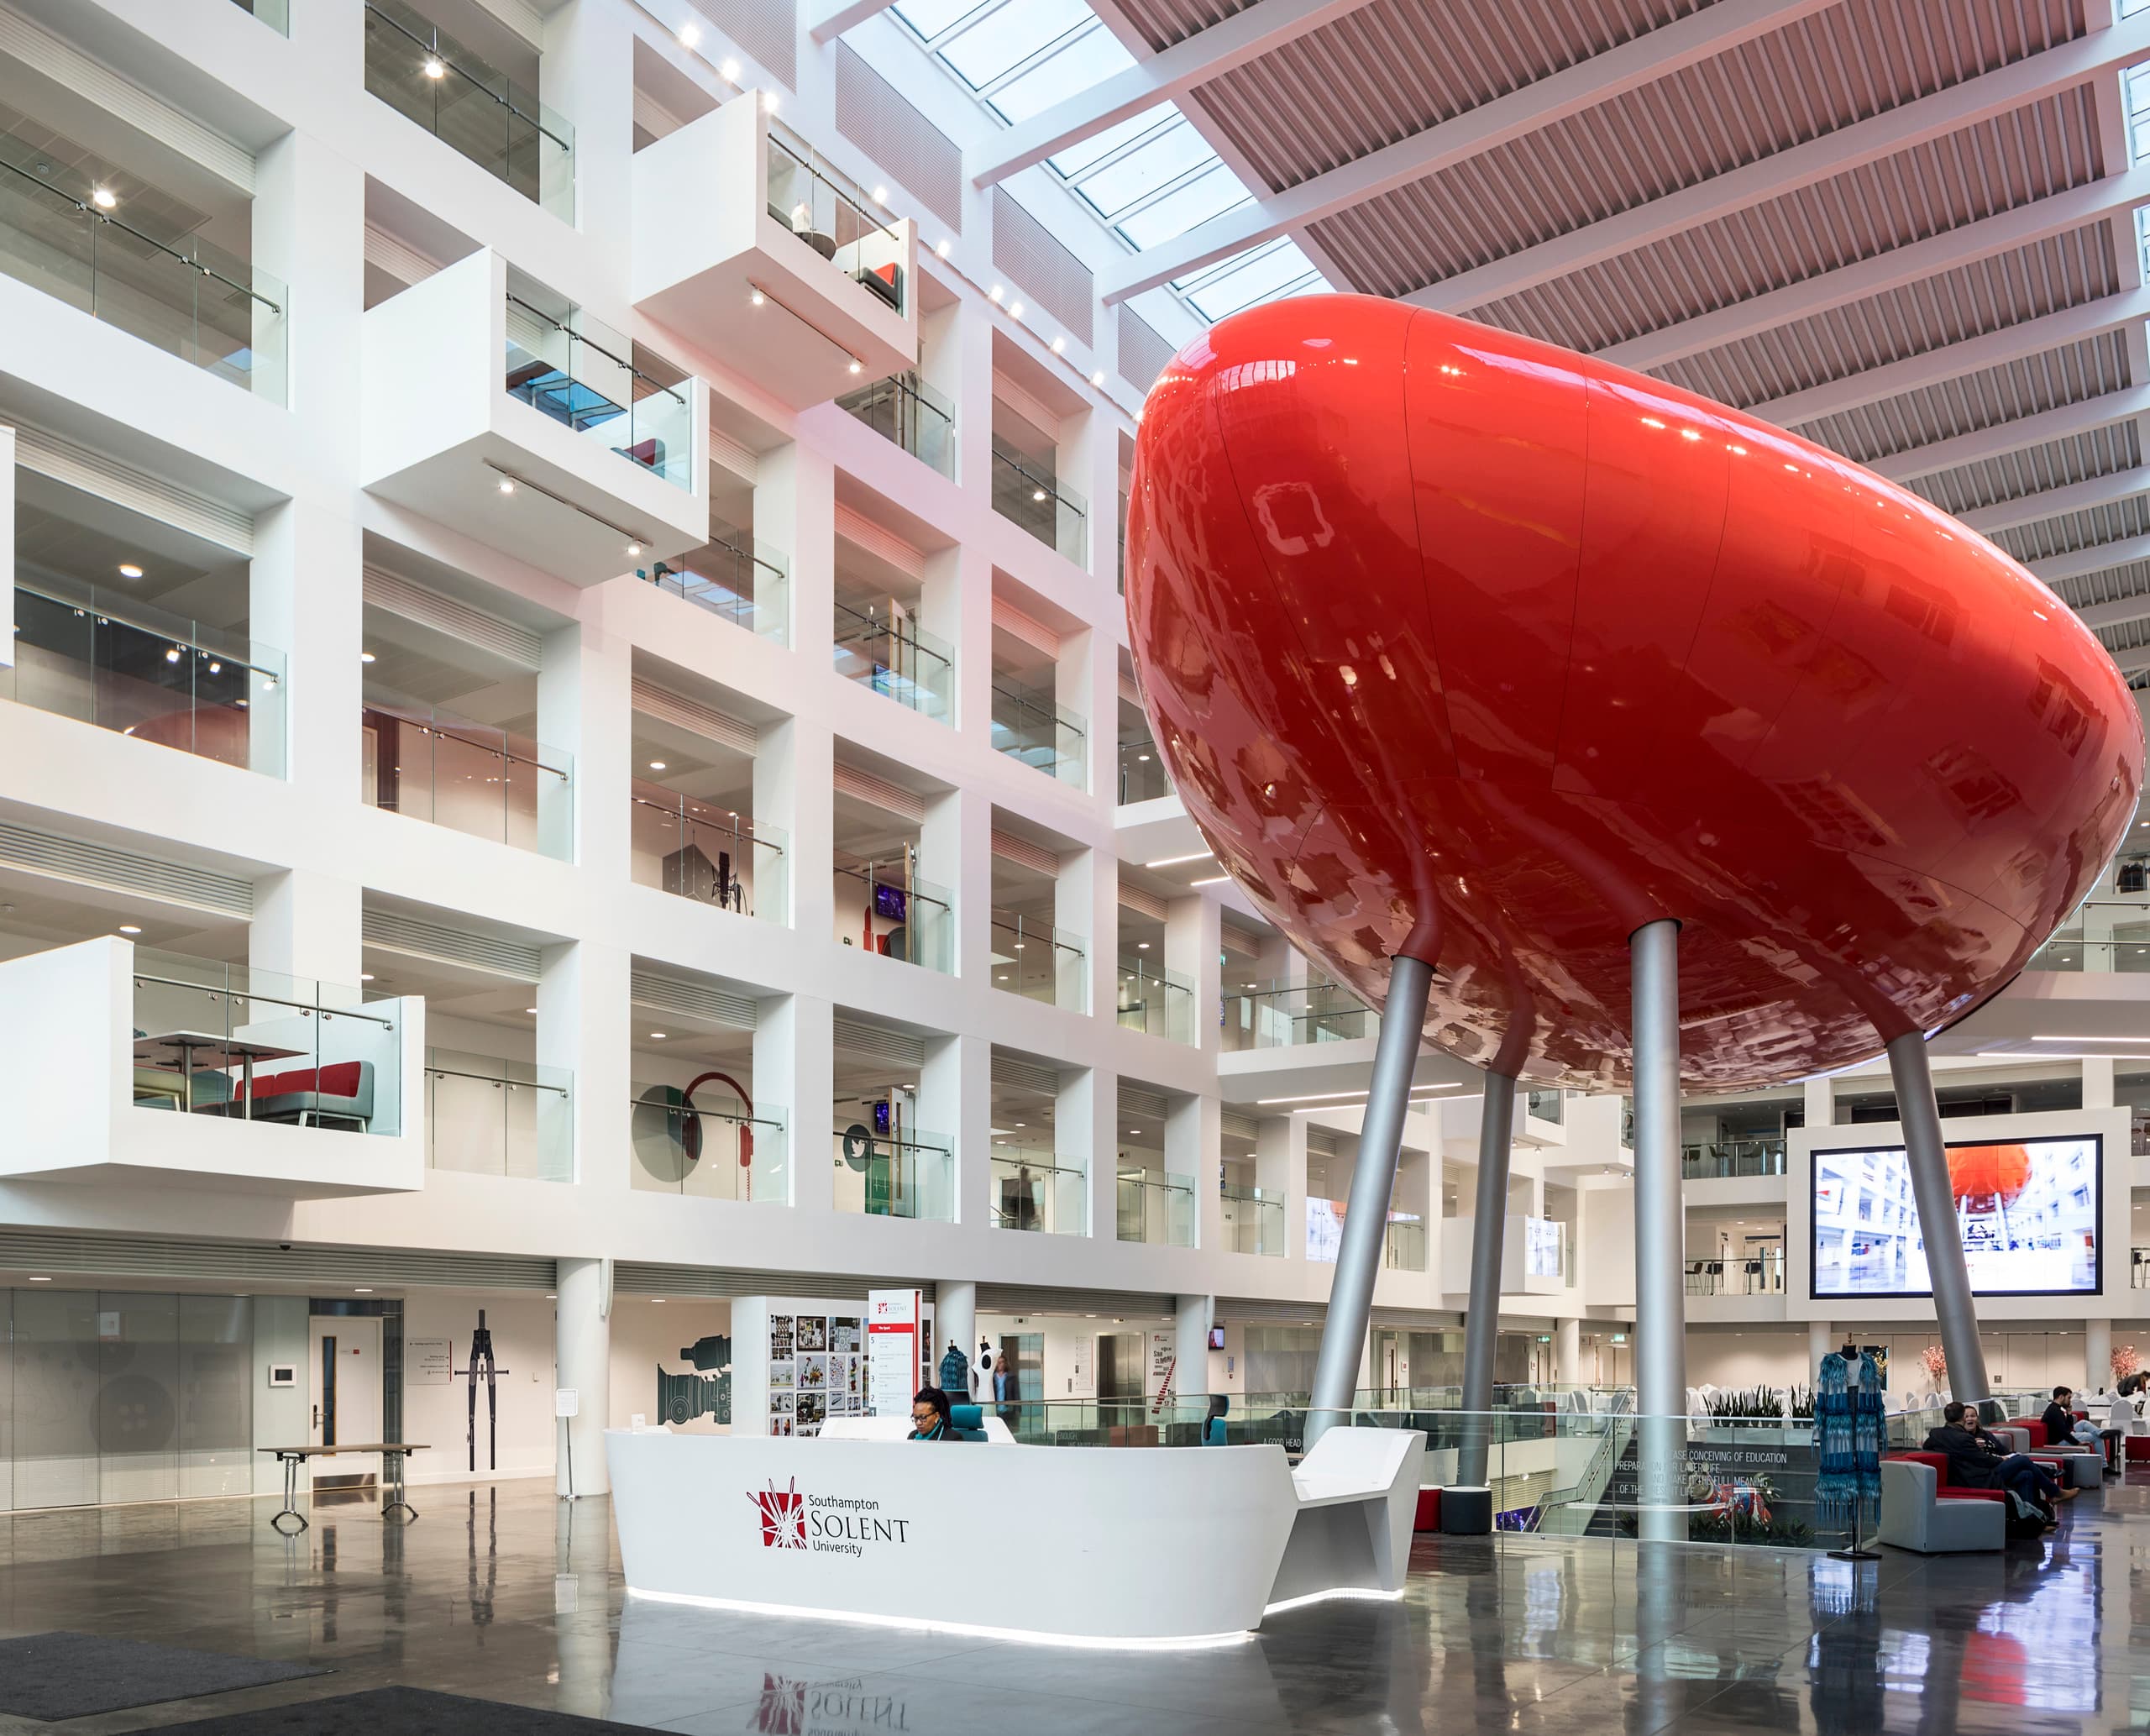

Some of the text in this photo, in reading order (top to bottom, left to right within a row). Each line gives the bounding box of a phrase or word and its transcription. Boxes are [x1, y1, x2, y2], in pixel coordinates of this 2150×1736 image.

[1285, 1439, 1301, 1447] HEAD
[1688, 1450, 1732, 1461] CONCEIVING
[1734, 1451, 1744, 1461] OF
[1746, 1452, 1787, 1464] EDUCATION
[1615, 1461, 1661, 1471] PREPARAON
[1734, 1476, 1768, 1487] MEANING
[1619, 1484, 1628, 1494] OF
[1631, 1485, 1644, 1495] THE
[808, 1494, 879, 1512] Southampton
[810, 1510, 910, 1543] SOLENT
[812, 1539, 863, 1557] University
